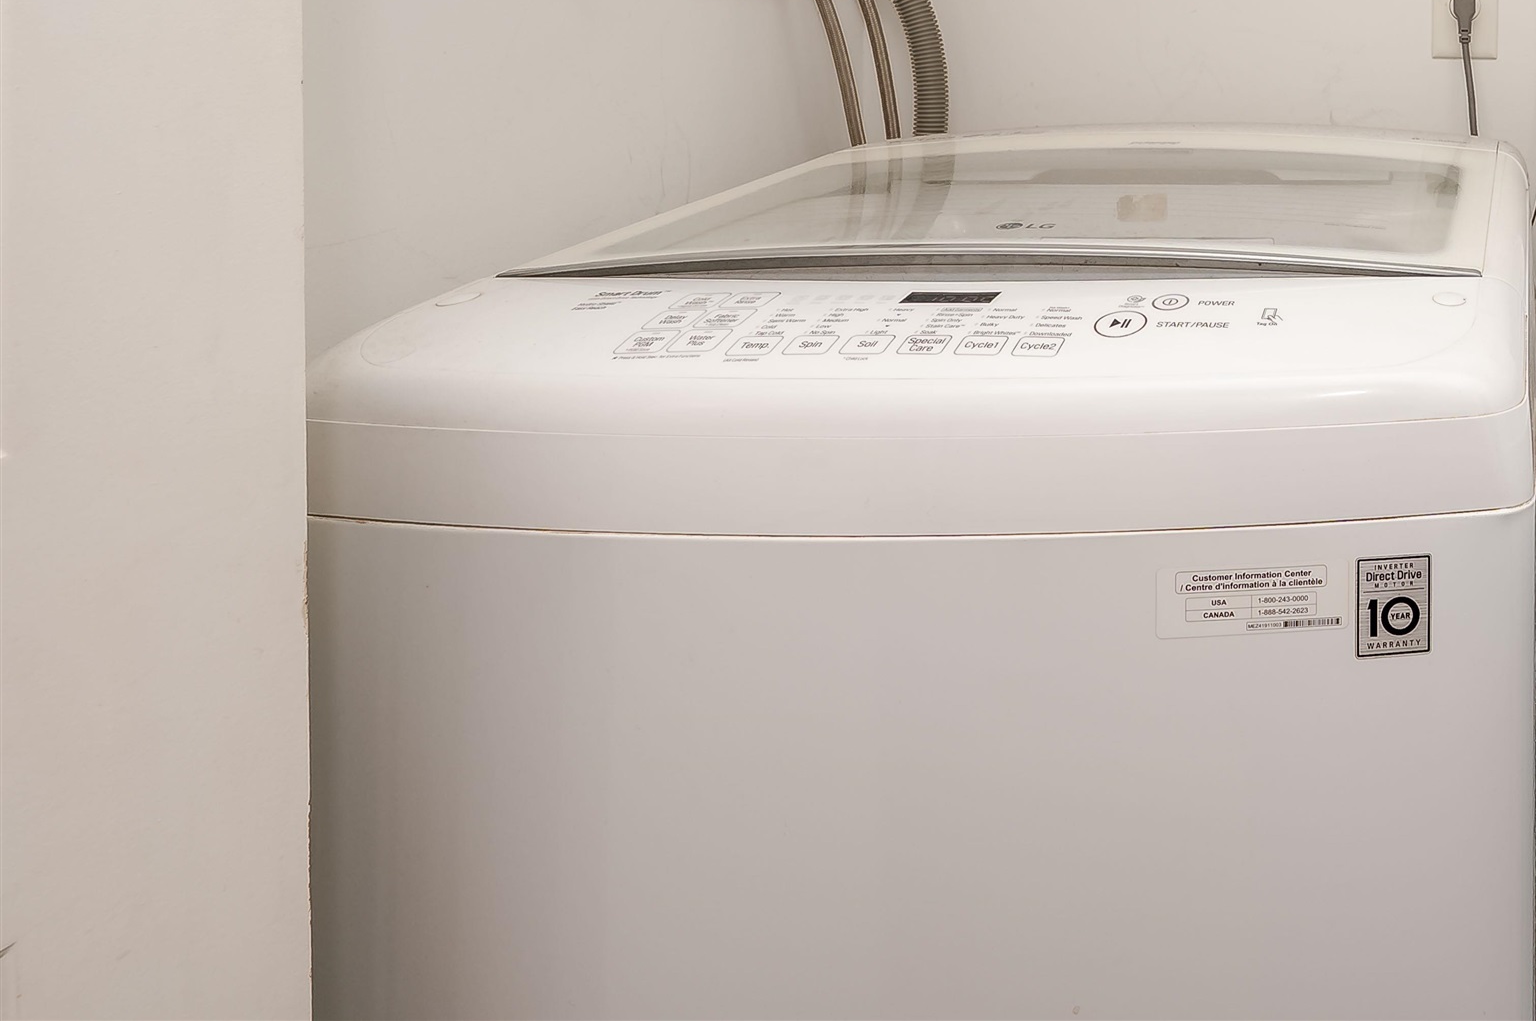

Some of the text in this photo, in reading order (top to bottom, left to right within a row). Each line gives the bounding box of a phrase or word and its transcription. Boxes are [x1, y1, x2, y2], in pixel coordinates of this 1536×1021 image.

[1156, 321, 1231, 329] START/PAUSE
[798, 340, 823, 350] Spin
[856, 340, 879, 348] Soil
[907, 337, 947, 345] Special
[964, 341, 1000, 349] Cycle1
[740, 342, 770, 350] Temp.
[908, 344, 934, 352] Care
[1020, 342, 1058, 351] Cycle2
[1374, 562, 1414, 571] INVERTER
[1191, 569, 1312, 583] Customer Information Center
[1365, 570, 1422, 582] Direct Drive
[1185, 583, 1213, 591] Centre
[1214, 580, 1270, 591] d'information
[1271, 579, 1277, 587] à
[1278, 579, 1287, 587] la
[1288, 577, 1323, 587] clientèle
[1374, 581, 1414, 589] MOTOR
[1257, 594, 1309, 604] 1-800-243-0000
[1203, 607, 1309, 619] CANADA 1-888-542-2623
[1367, 596, 1421, 638] 10
[1390, 612, 1411, 620] YEAR
[1366, 639, 1421, 650] WARRANTY
